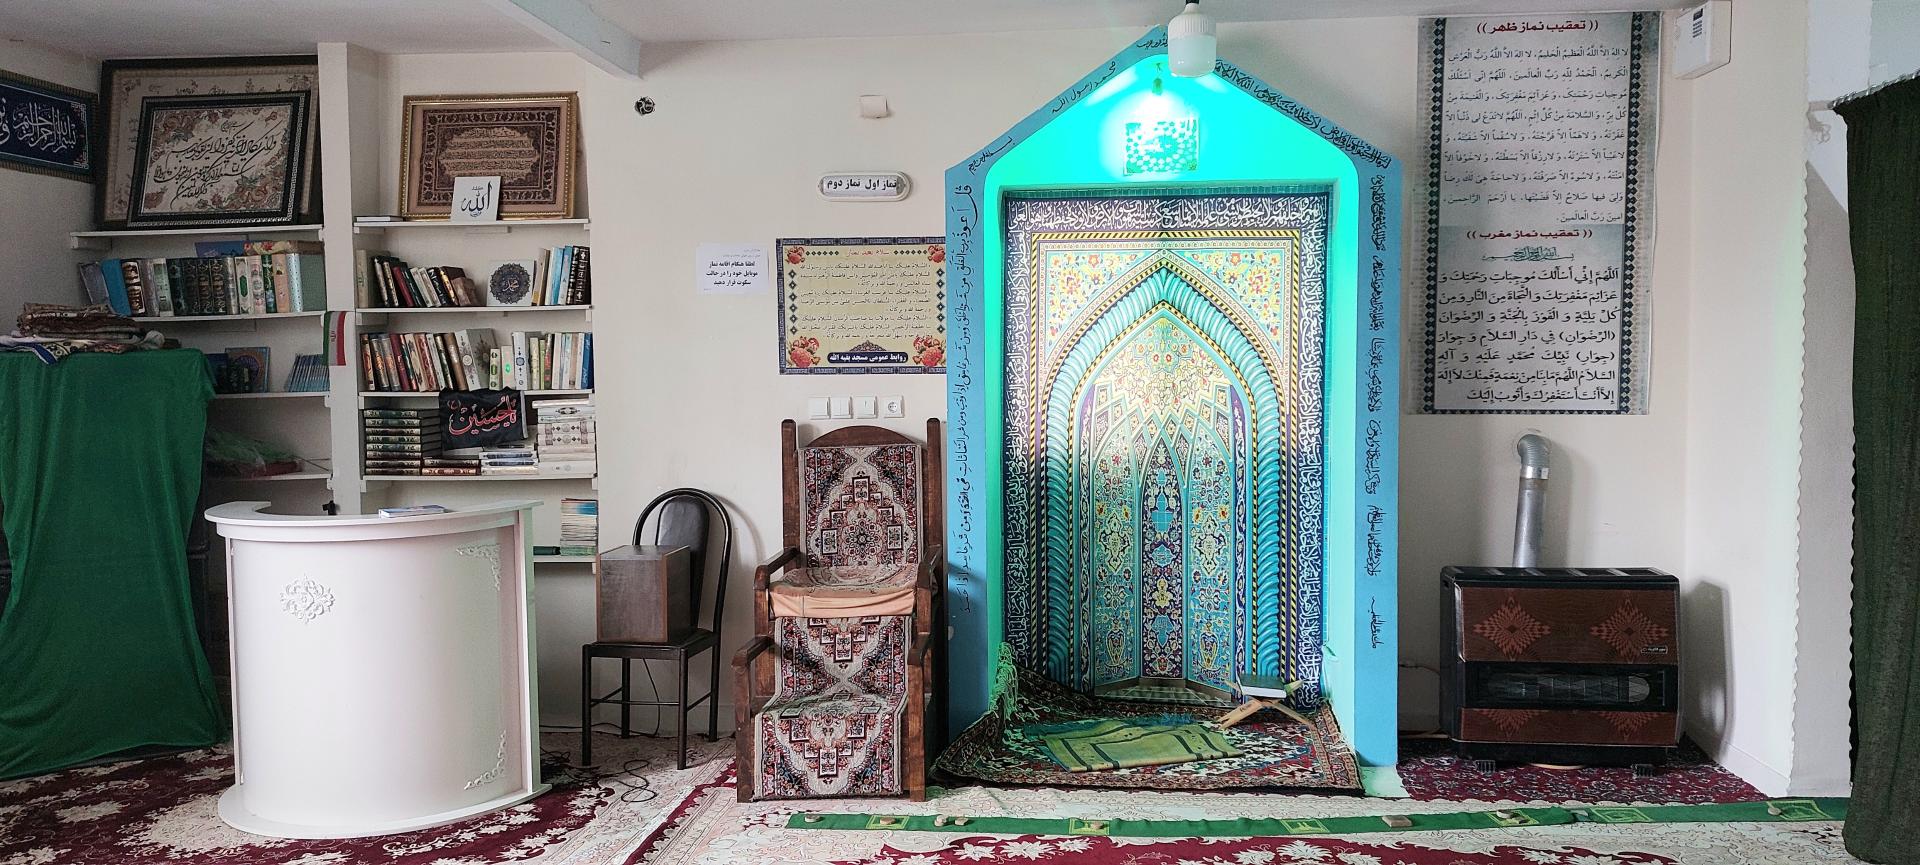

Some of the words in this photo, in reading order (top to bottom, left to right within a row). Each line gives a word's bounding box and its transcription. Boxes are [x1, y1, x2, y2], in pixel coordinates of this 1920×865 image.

[1490, 22, 1517, 34] ظهر
[1519, 21, 1544, 33] نماز
[1547, 20, 1585, 33] تعقیب
[1095, 61, 1116, 86] محمد
[1071, 81, 1093, 101] رسول
[1051, 97, 1069, 114] الله
[827, 179, 843, 190] دوم
[845, 178, 860, 190] نماز
[865, 179, 879, 191] اول
[882, 179, 897, 191] نماز
[461, 180, 493, 212] الله
[1480, 231, 1512, 239] مغرب
[1513, 230, 1537, 239] نماز
[1541, 229, 1580, 238] تعقیب
[853, 354, 868, 362] مسجد
[869, 354, 888, 363] عمومی
[889, 353, 906, 363] روابط
